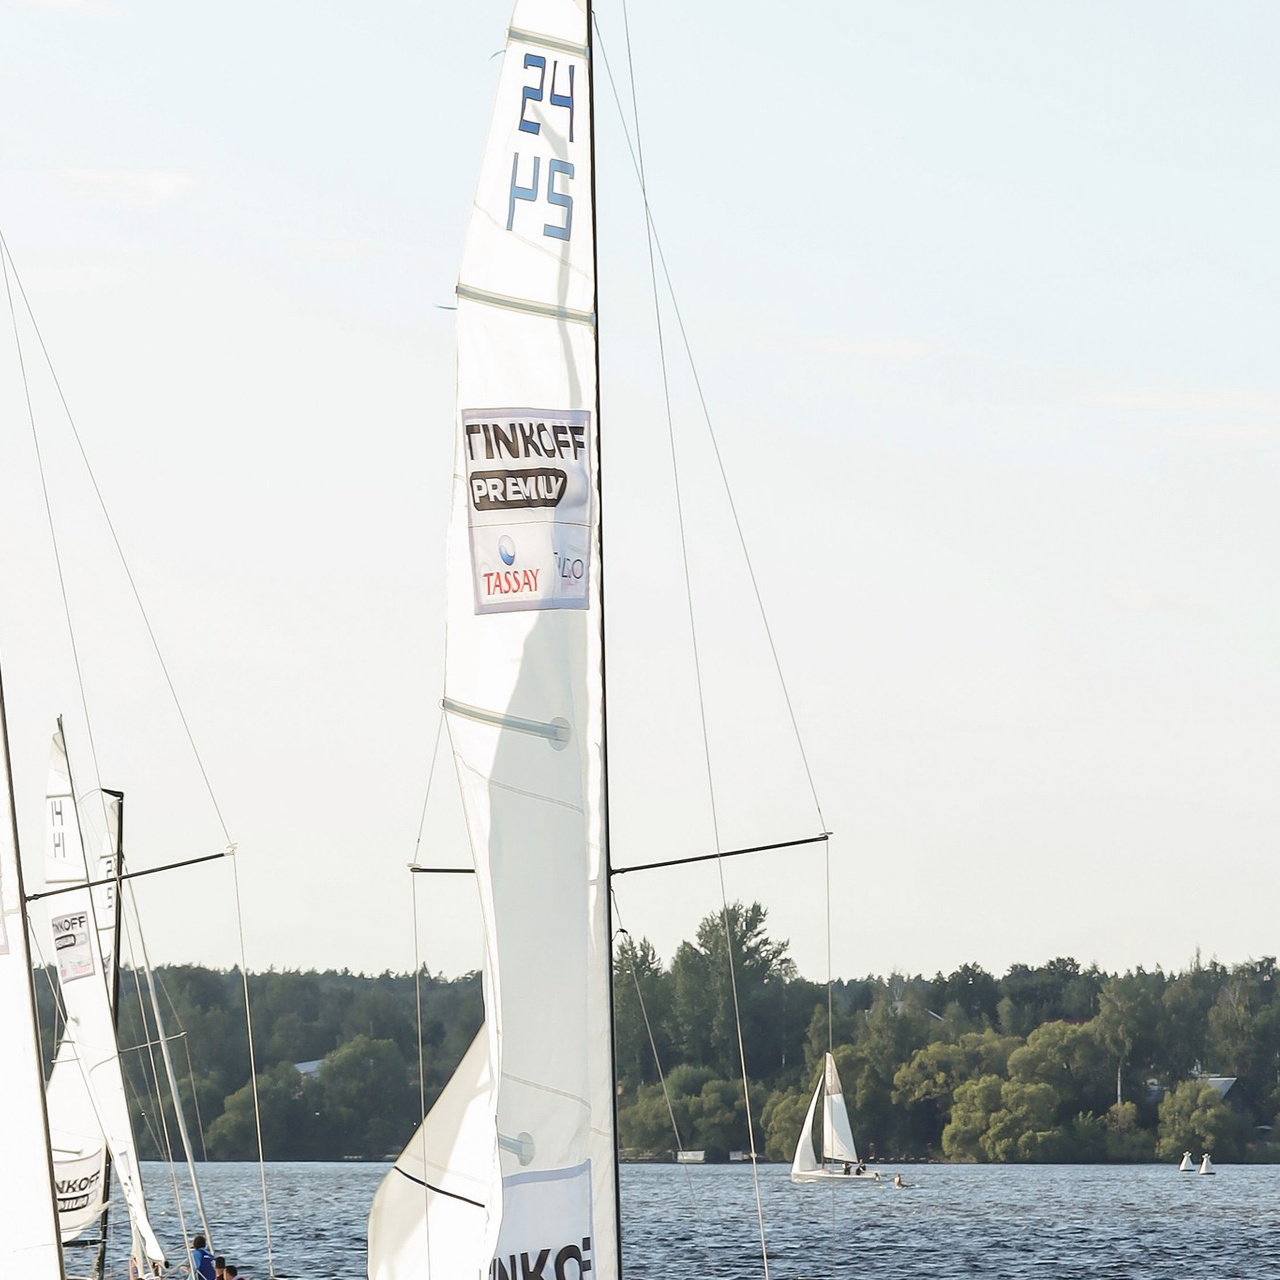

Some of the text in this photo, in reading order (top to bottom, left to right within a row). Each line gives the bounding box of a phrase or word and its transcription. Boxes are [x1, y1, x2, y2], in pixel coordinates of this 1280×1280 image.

[518, 53, 576, 143] 24
[466, 423, 585, 461] TINKOFF
[483, 569, 540, 596] TASSAY
